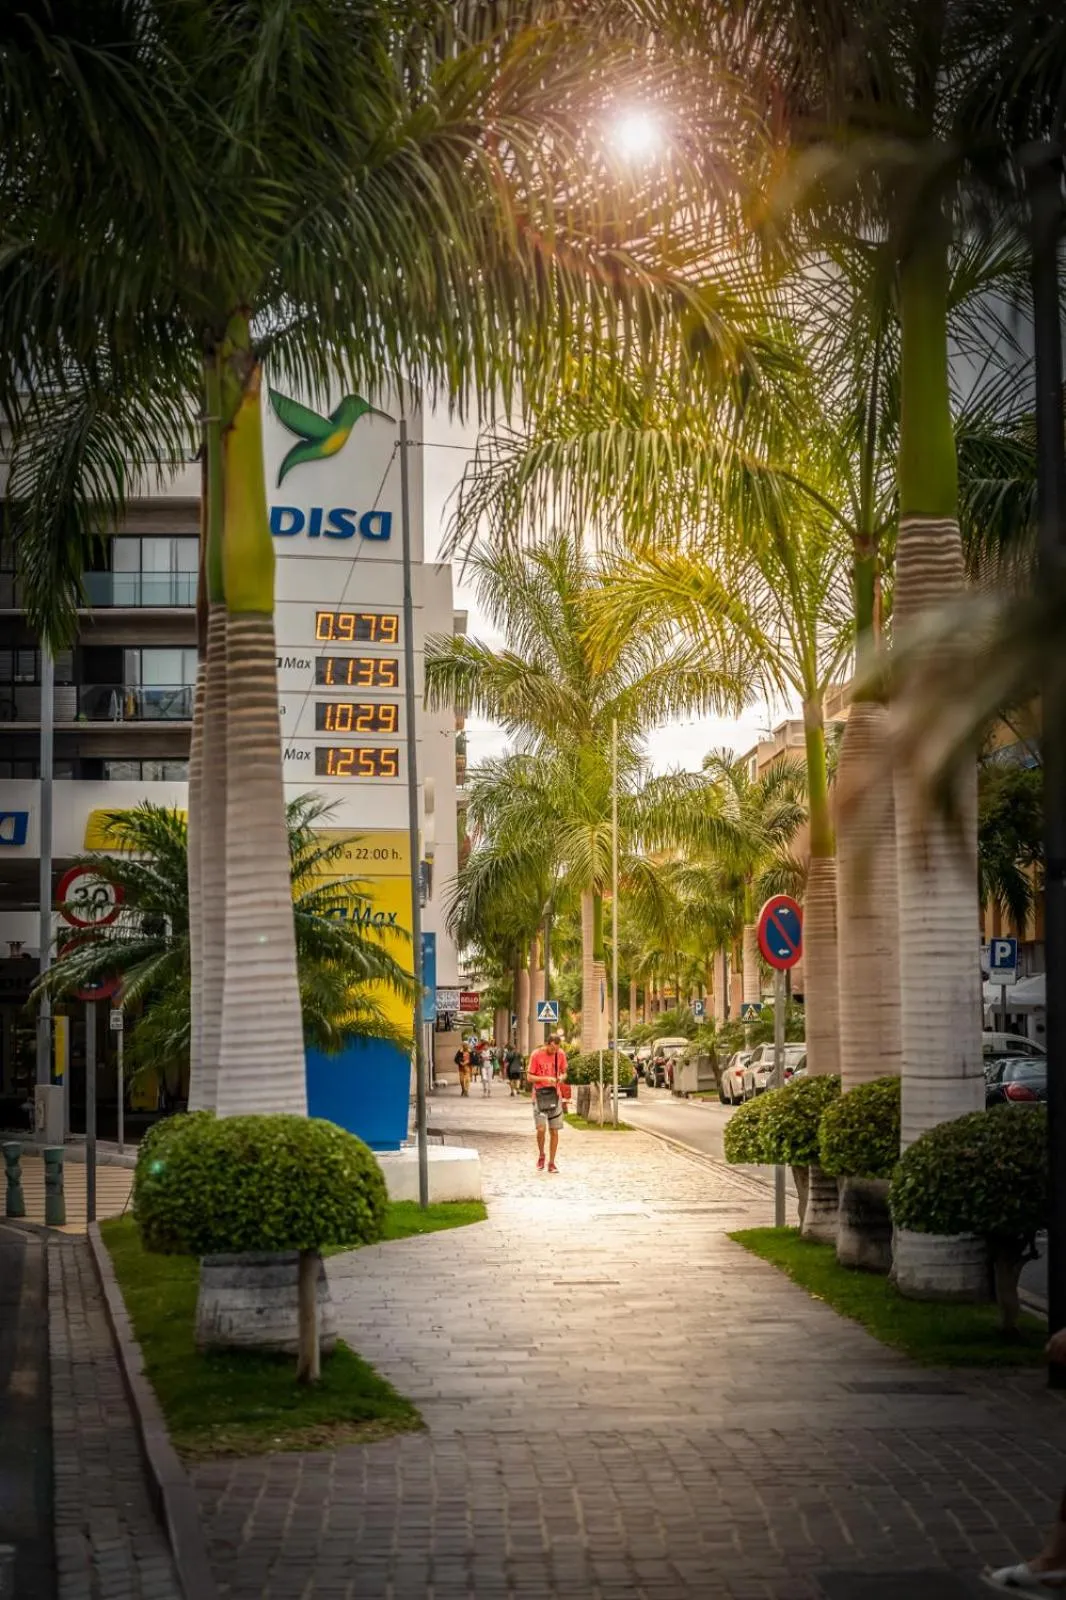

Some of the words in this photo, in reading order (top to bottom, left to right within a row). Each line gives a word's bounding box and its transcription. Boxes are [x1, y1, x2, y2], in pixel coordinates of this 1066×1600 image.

[284, 656, 311, 669] Max
[284, 748, 311, 761] Max
[356, 848, 388, 860] 22:00
[75, 887, 109, 908] 30
[995, 941, 1011, 966] P
[695, 1002, 702, 1014] P
